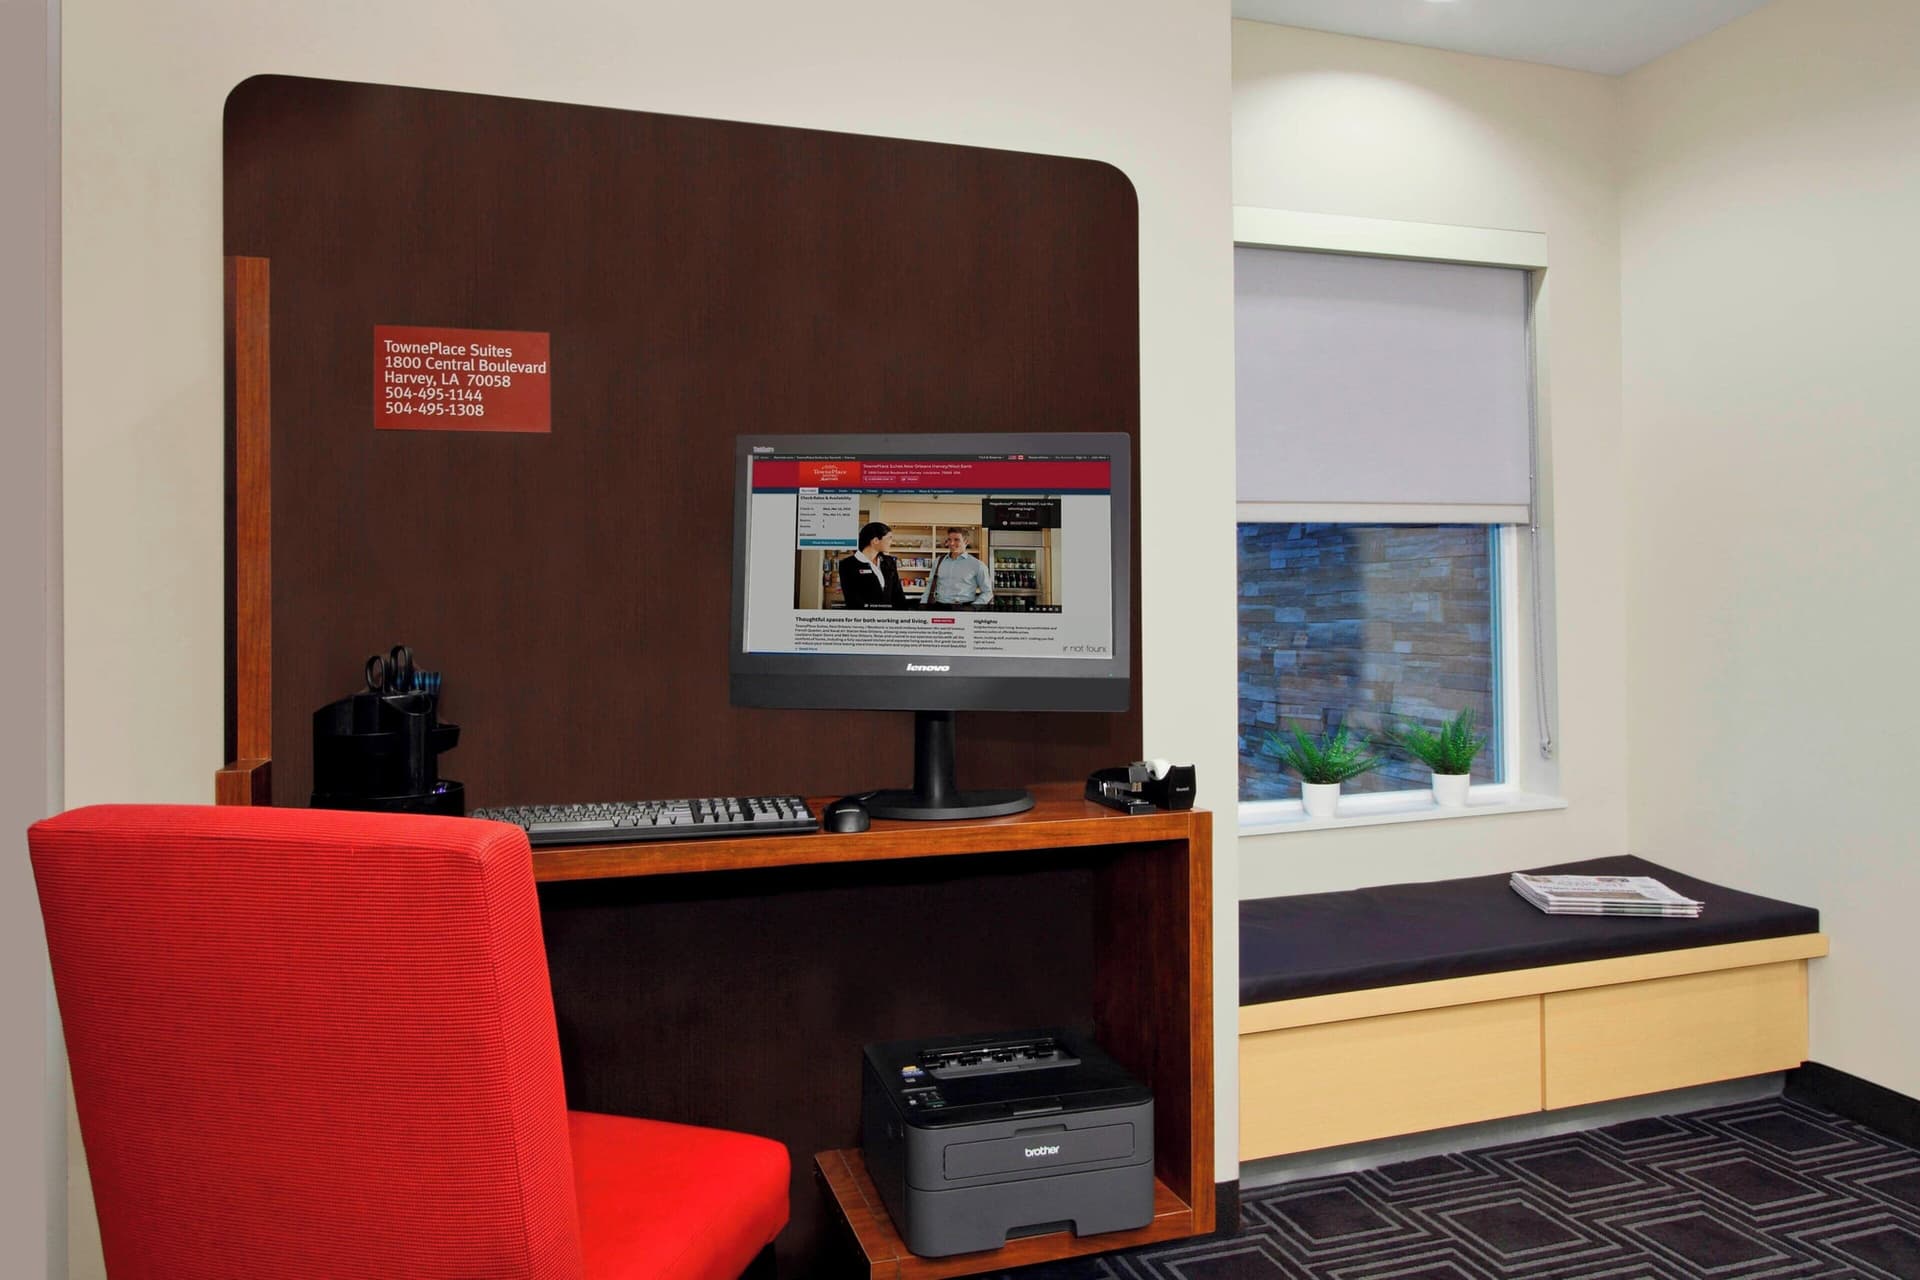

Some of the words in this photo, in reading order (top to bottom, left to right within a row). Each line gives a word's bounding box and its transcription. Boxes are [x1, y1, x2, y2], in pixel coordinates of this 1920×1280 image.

[384, 340, 466, 356] TownePlace
[470, 344, 513, 358] Suites
[385, 356, 421, 369] 1800
[425, 357, 475, 371] Central
[479, 359, 547, 374] Boulevard
[384, 371, 437, 387] Harvey,
[441, 373, 460, 386] LA
[467, 374, 512, 388] 70058
[385, 386, 483, 402] 504-495-1144
[385, 401, 485, 417] 504-495-1308
[906, 663, 950, 672] lenovo
[1024, 1145, 1060, 1157] brother
